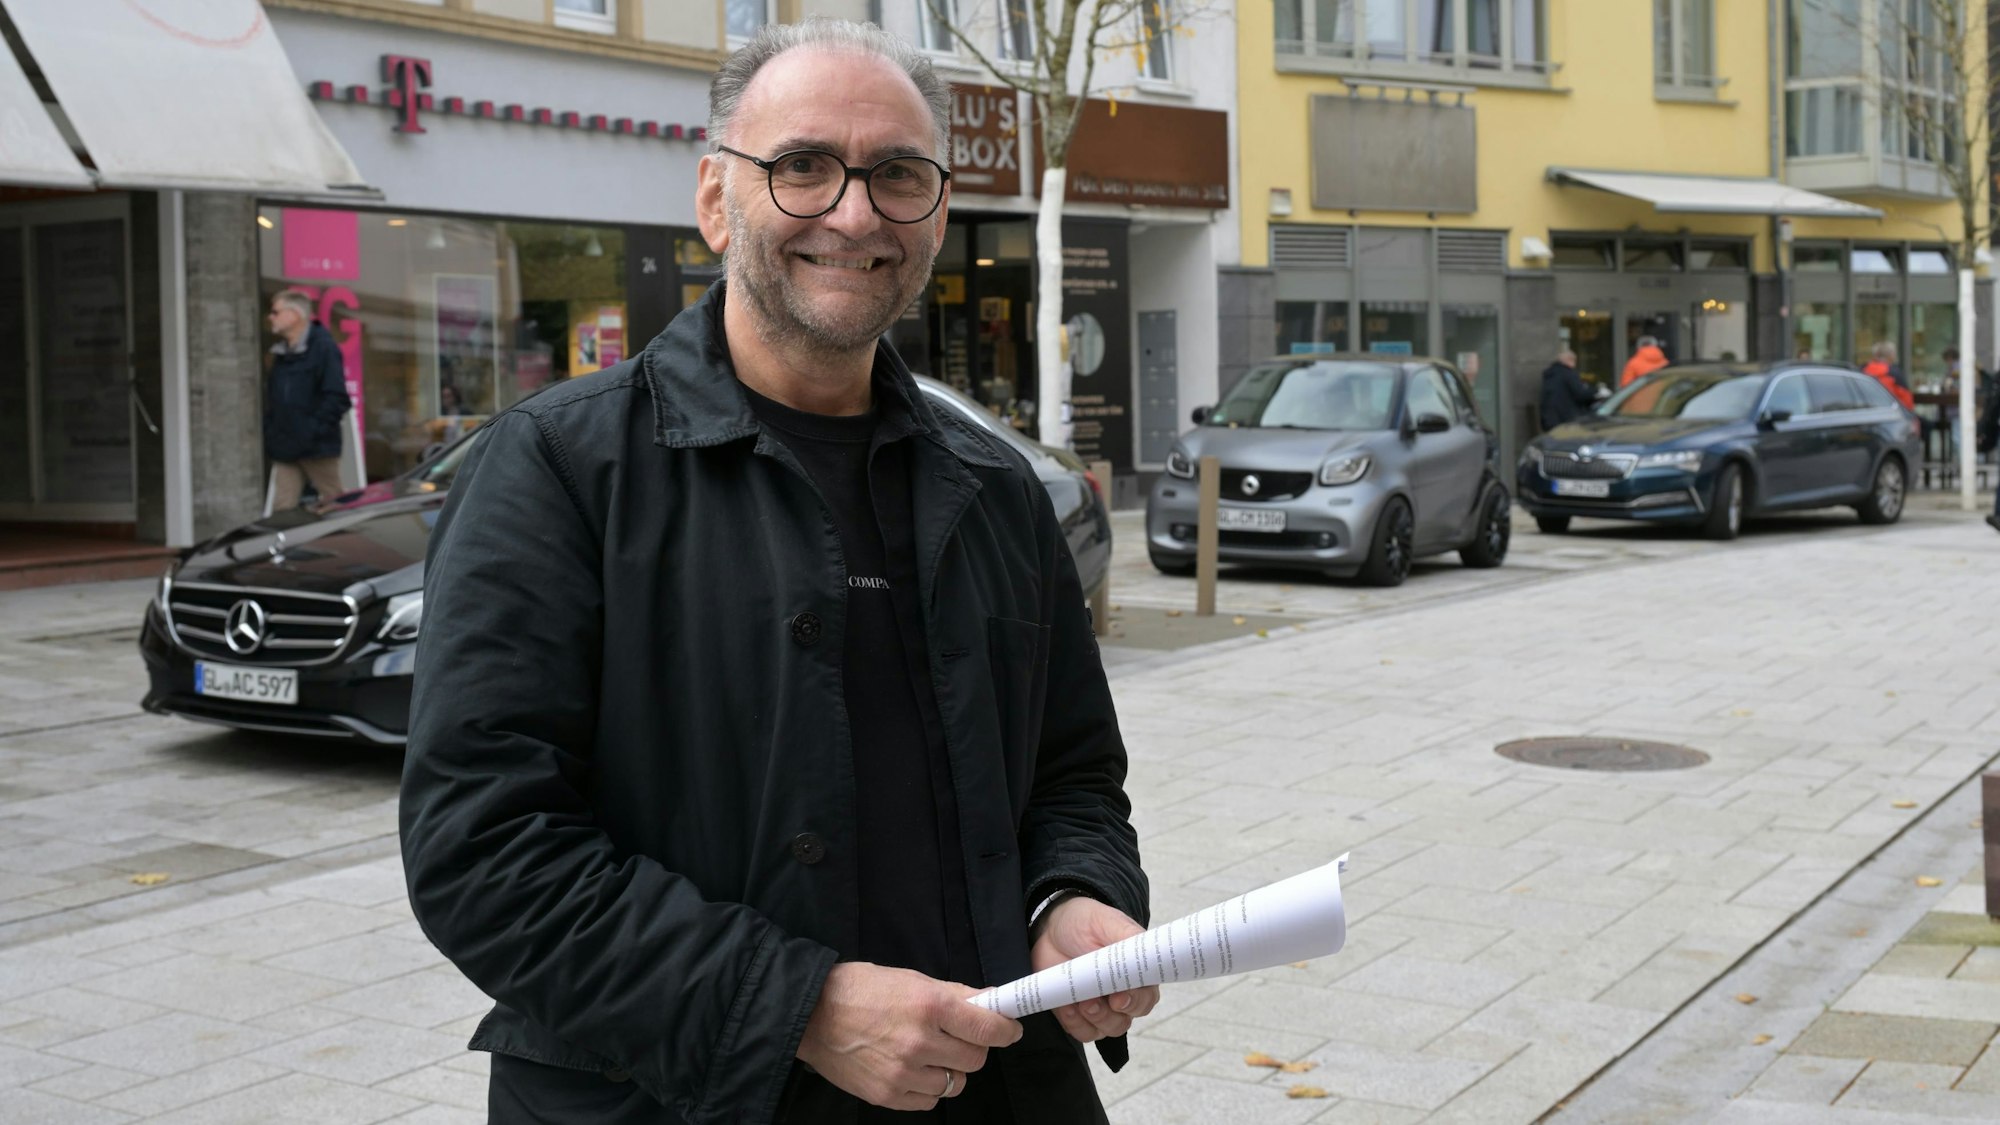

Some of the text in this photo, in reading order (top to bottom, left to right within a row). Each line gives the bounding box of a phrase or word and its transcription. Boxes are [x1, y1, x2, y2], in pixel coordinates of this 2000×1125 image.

[380, 54, 432, 134] T
[952, 133, 1017, 171] BOX
[641, 256, 657, 274] 24
[848, 575, 890, 589] COMPA
[230, 671, 254, 695] AC
[257, 675, 293, 699] 597
